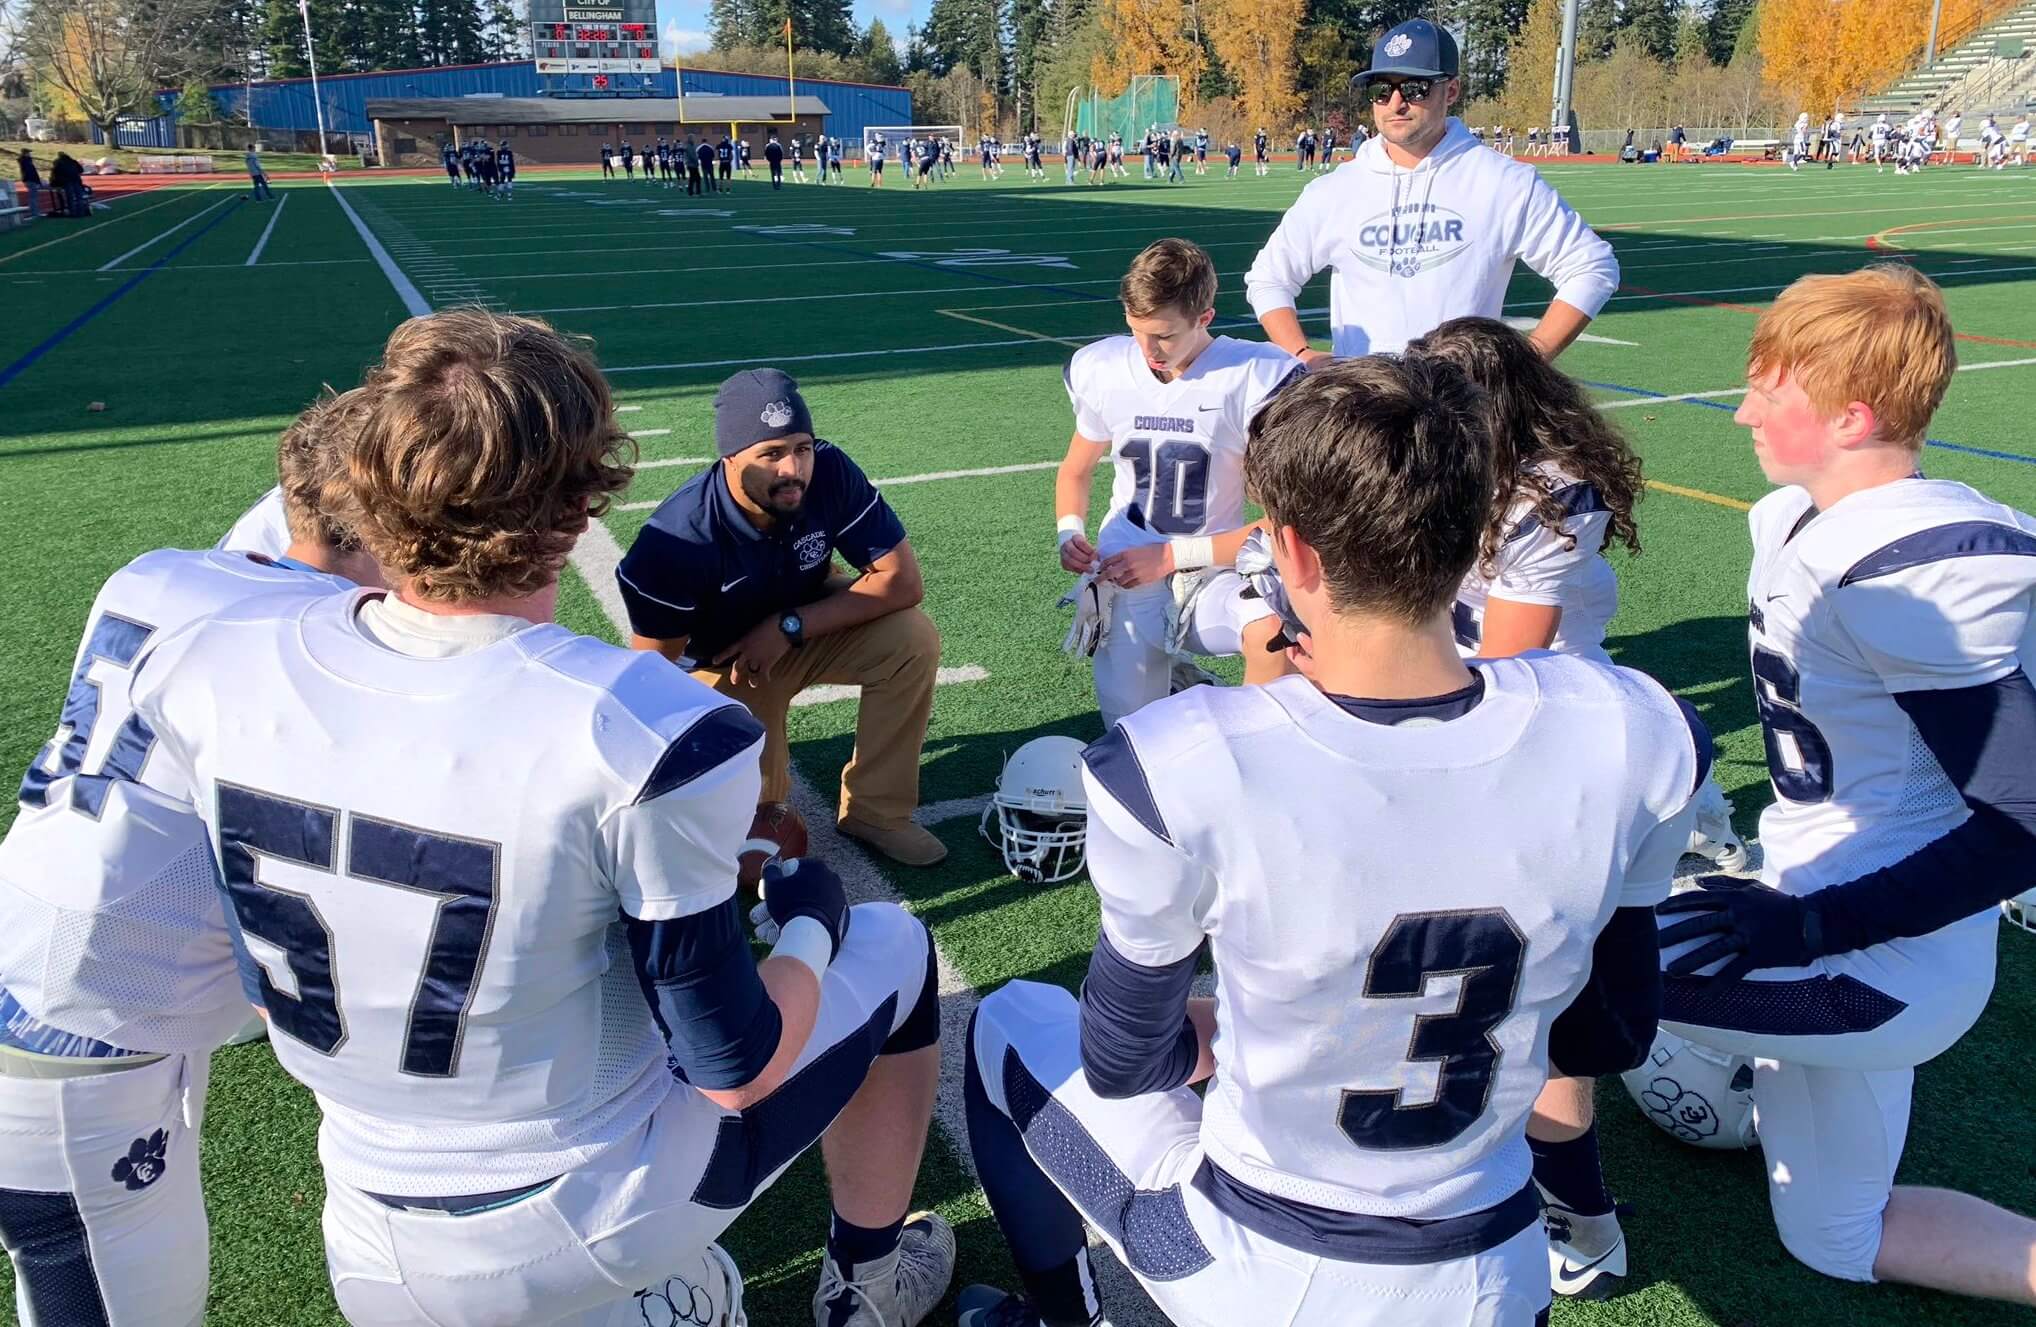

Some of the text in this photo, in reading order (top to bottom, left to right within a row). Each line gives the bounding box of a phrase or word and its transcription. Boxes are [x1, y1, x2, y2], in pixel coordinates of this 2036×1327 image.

[568, 10, 622, 20] BELLINGHAM
[1359, 219, 1464, 248] COUGAR
[1134, 415, 1195, 433] COUGARS
[1119, 438, 1212, 536] 10
[793, 530, 826, 550] CASCADE
[213, 777, 502, 1078] 57
[1335, 906, 1530, 1152] 3
